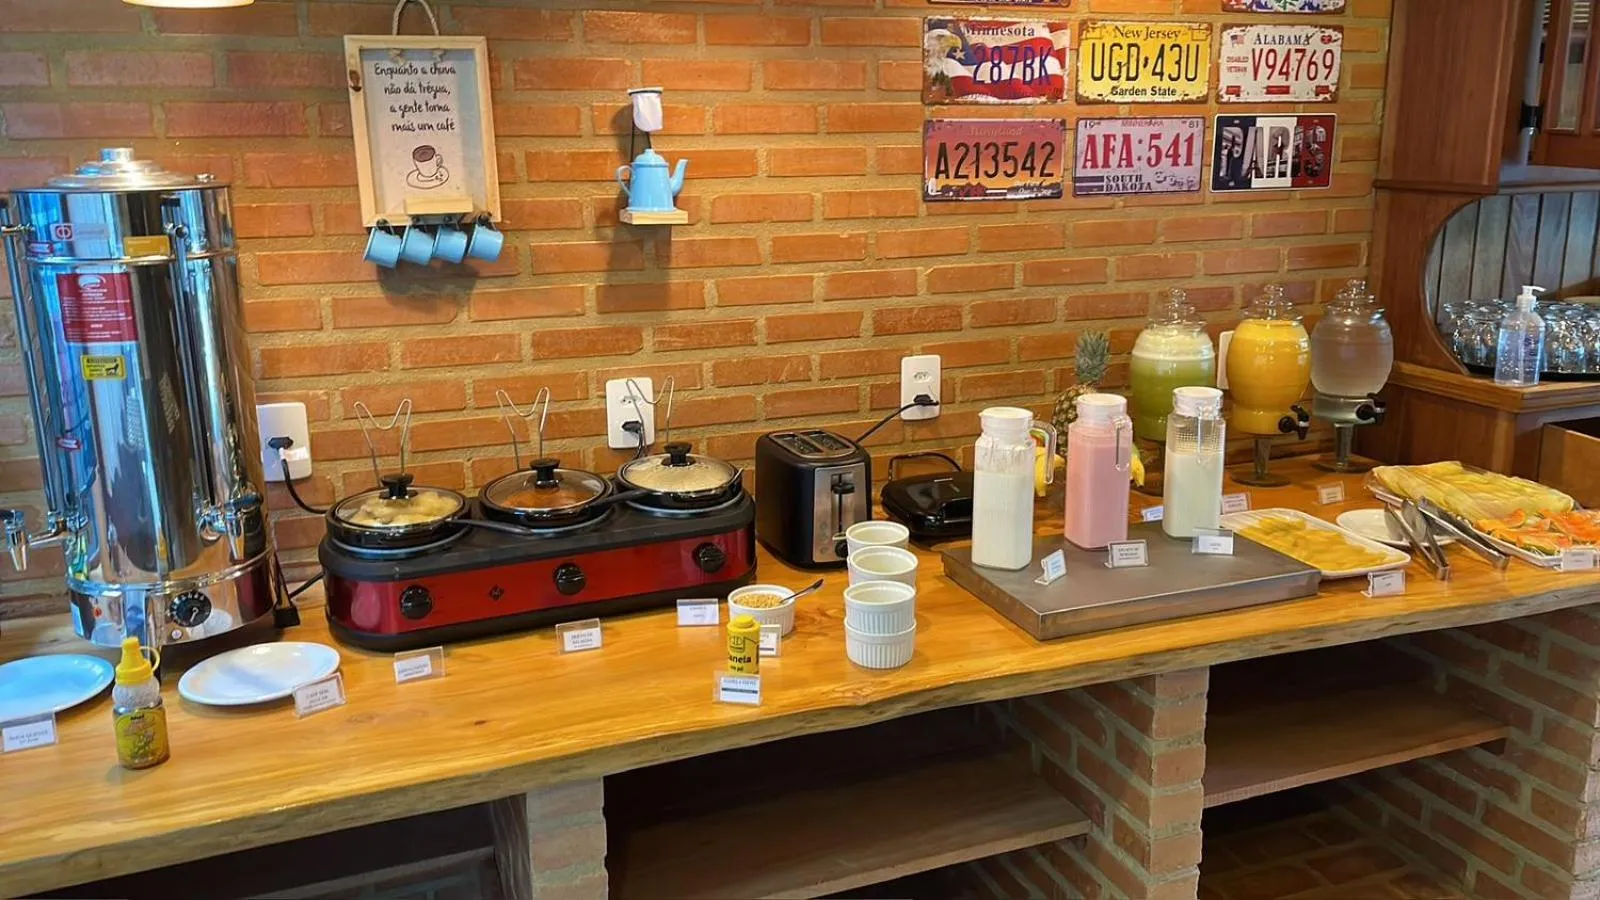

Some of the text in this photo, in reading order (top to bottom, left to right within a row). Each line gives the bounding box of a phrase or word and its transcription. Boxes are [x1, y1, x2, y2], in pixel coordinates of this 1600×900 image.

[962, 24, 1036, 37] Minnesota
[1113, 25, 1182, 41] New Jersey
[1254, 34, 1310, 45] ALABAMA
[374, 62, 456, 79] Enquanto a chuva
[972, 45, 1052, 85] 287BK
[1252, 48, 1334, 81] V94769
[384, 81, 451, 99] não dá trégua,
[1111, 86, 1177, 96] Garden State
[389, 104, 397, 113] a
[399, 99, 423, 118] gente
[391, 117, 455, 132] mais um café
[1081, 132, 1195, 169] AFA:541
[1219, 126, 1327, 178] PARIS
[935, 141, 1056, 180] A213542
[1104, 182, 1152, 192] DAKOTA
[1105, 174, 1143, 183] SOUTH
